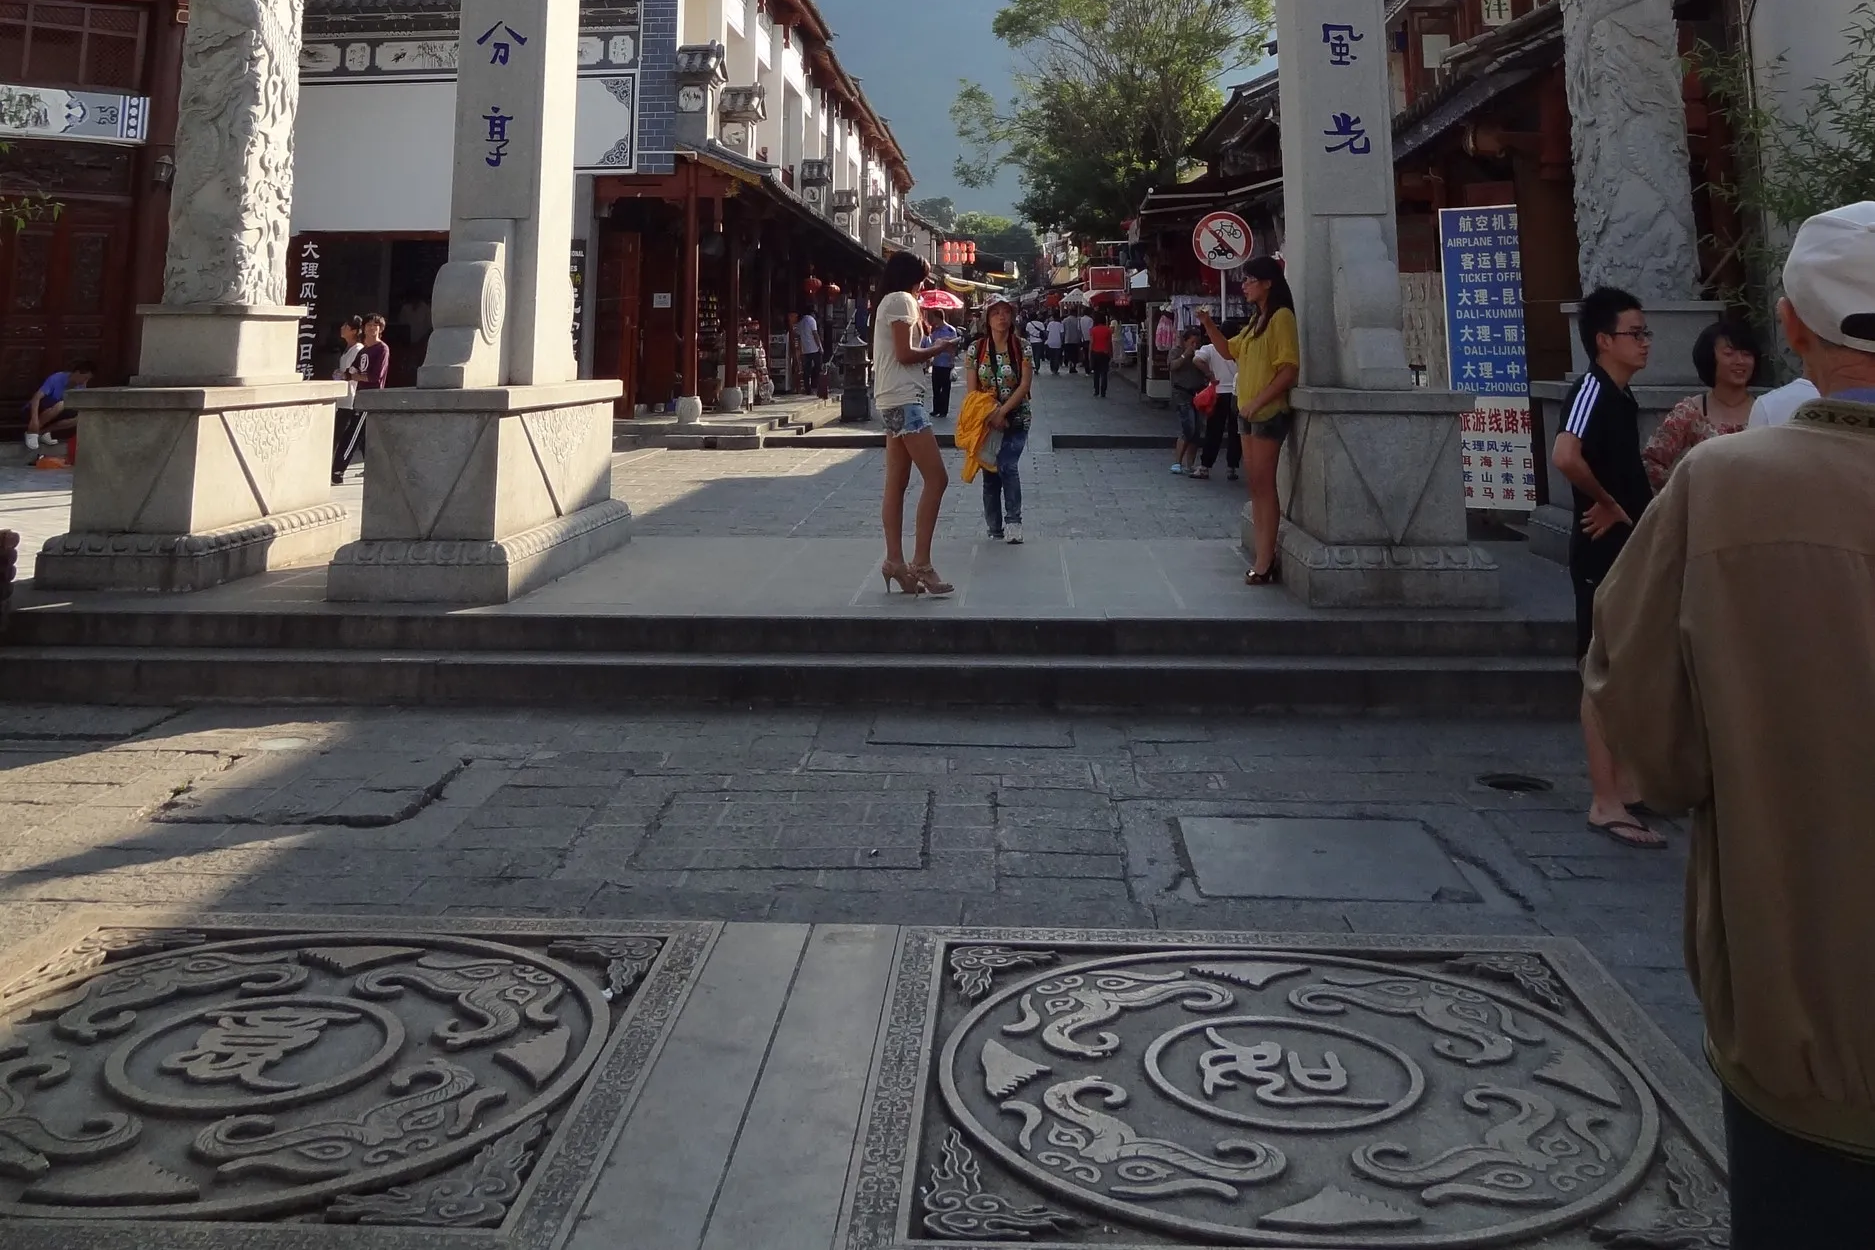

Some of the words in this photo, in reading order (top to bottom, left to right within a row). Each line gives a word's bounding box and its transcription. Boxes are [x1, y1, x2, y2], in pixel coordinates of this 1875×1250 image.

[1447, 237, 1492, 248] AIRPLANE
[1459, 273, 1493, 283] TICKET
[1462, 361, 1528, 379] 大理-中
[1457, 382, 1528, 392] DALI-ZHONGD
